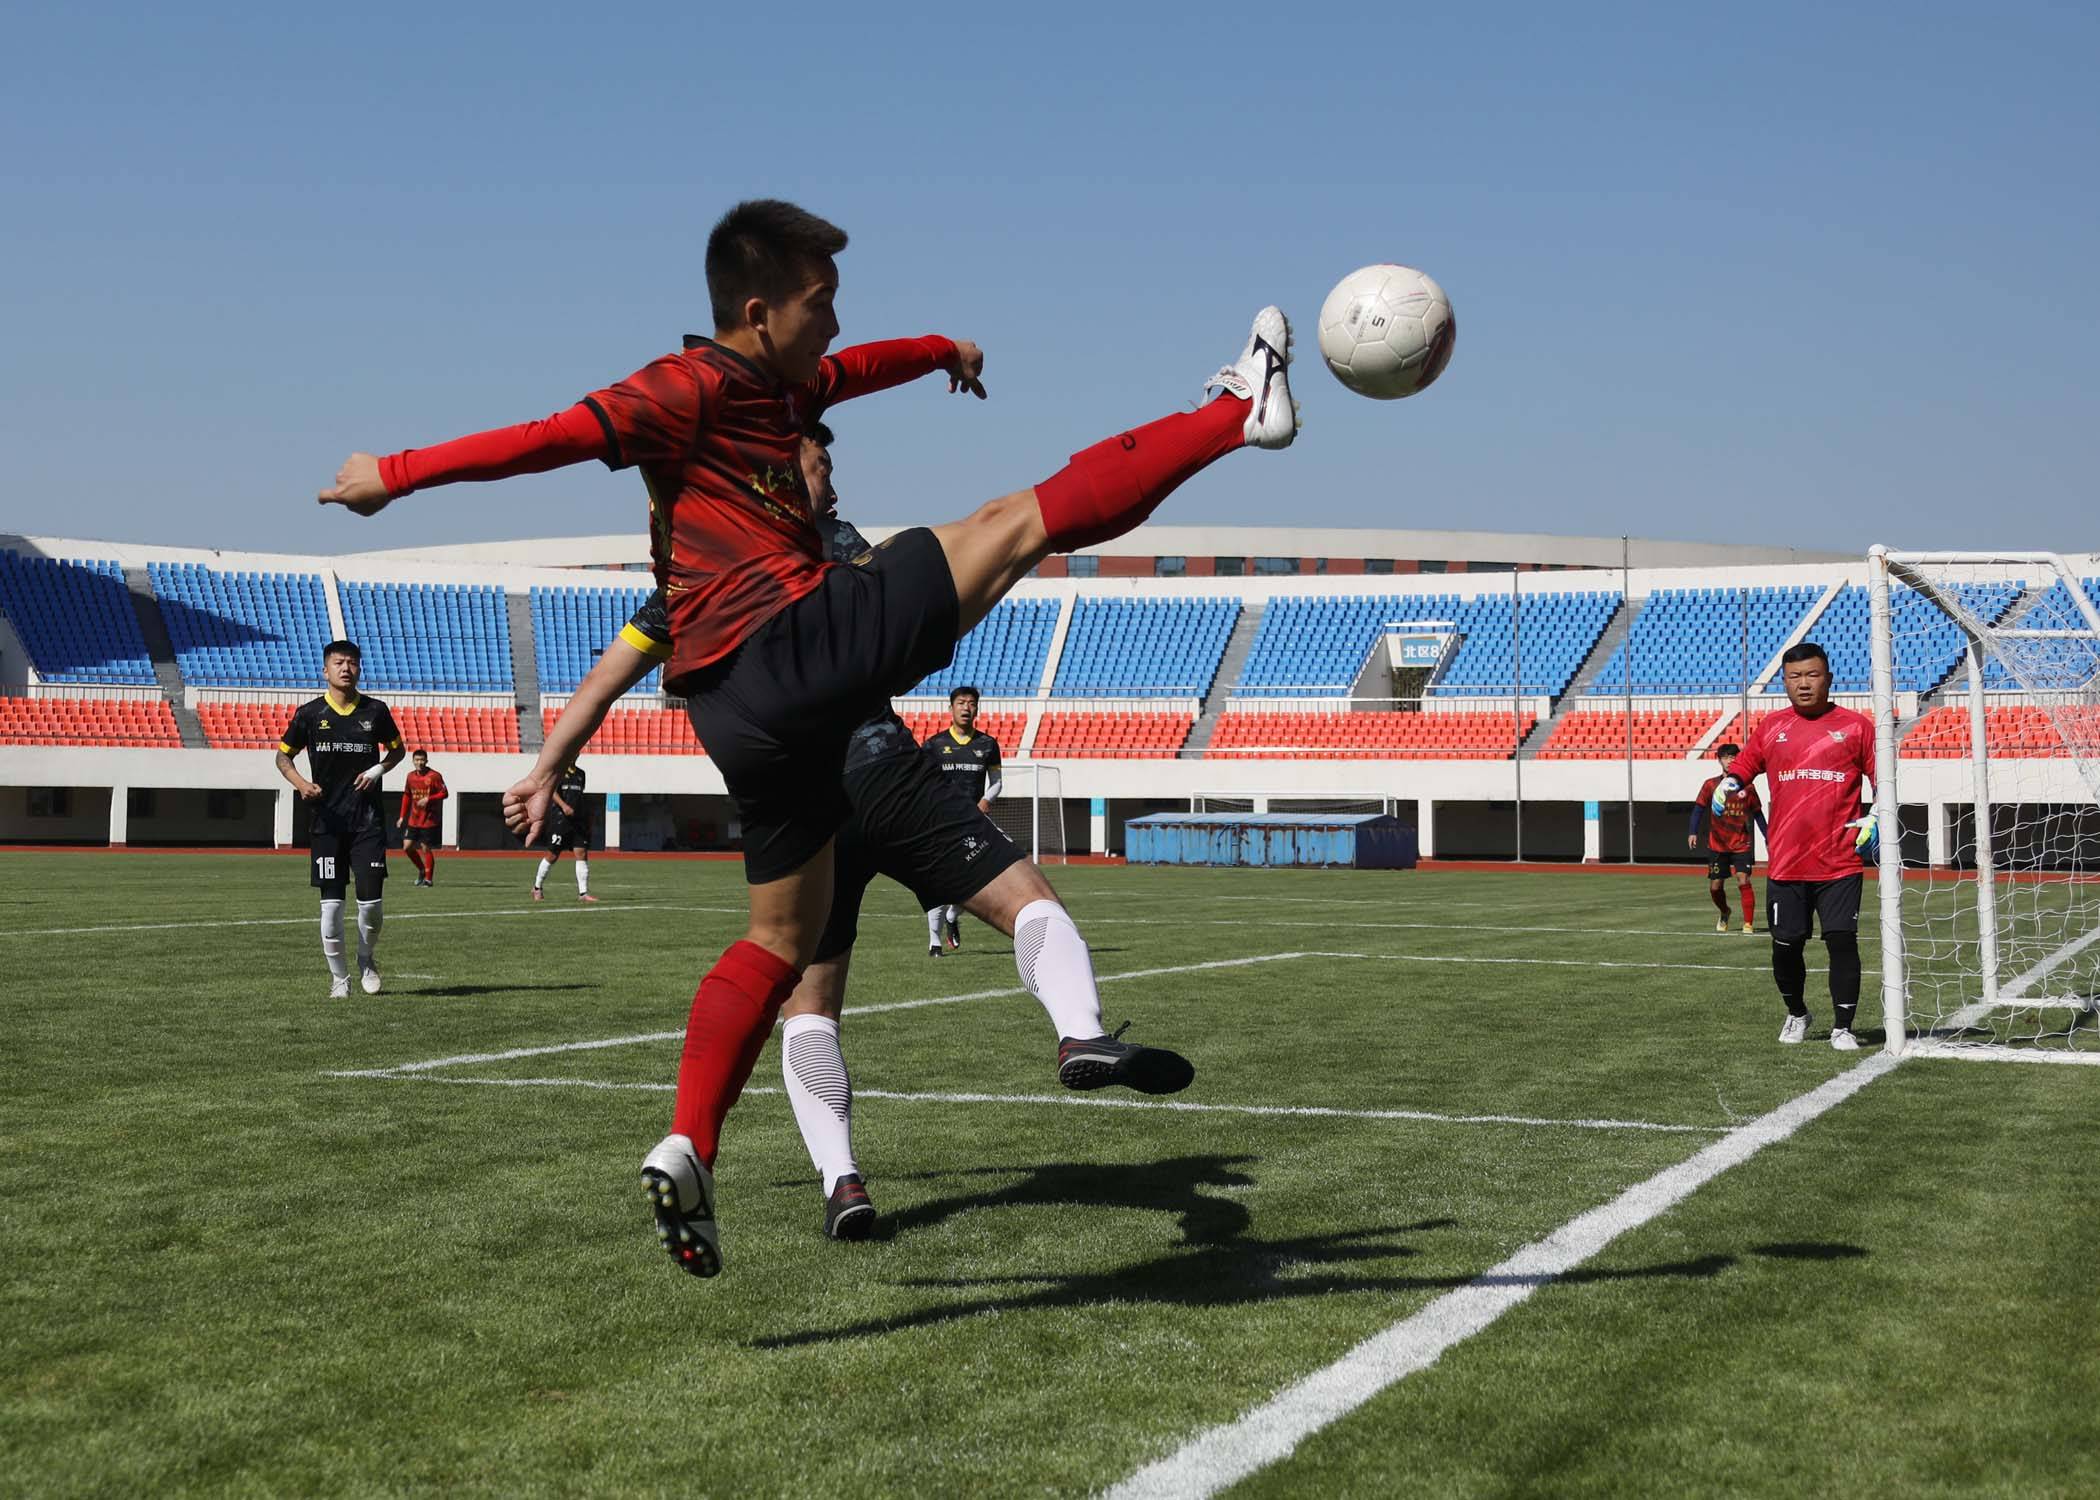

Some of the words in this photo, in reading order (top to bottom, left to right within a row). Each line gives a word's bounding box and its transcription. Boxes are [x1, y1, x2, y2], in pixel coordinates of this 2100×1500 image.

[1371, 315, 1385, 328] 5
[1403, 645, 1440, 658] 北区8
[551, 833, 562, 846] 92
[316, 856, 335, 879] 16
[1773, 902, 1778, 926] 1
